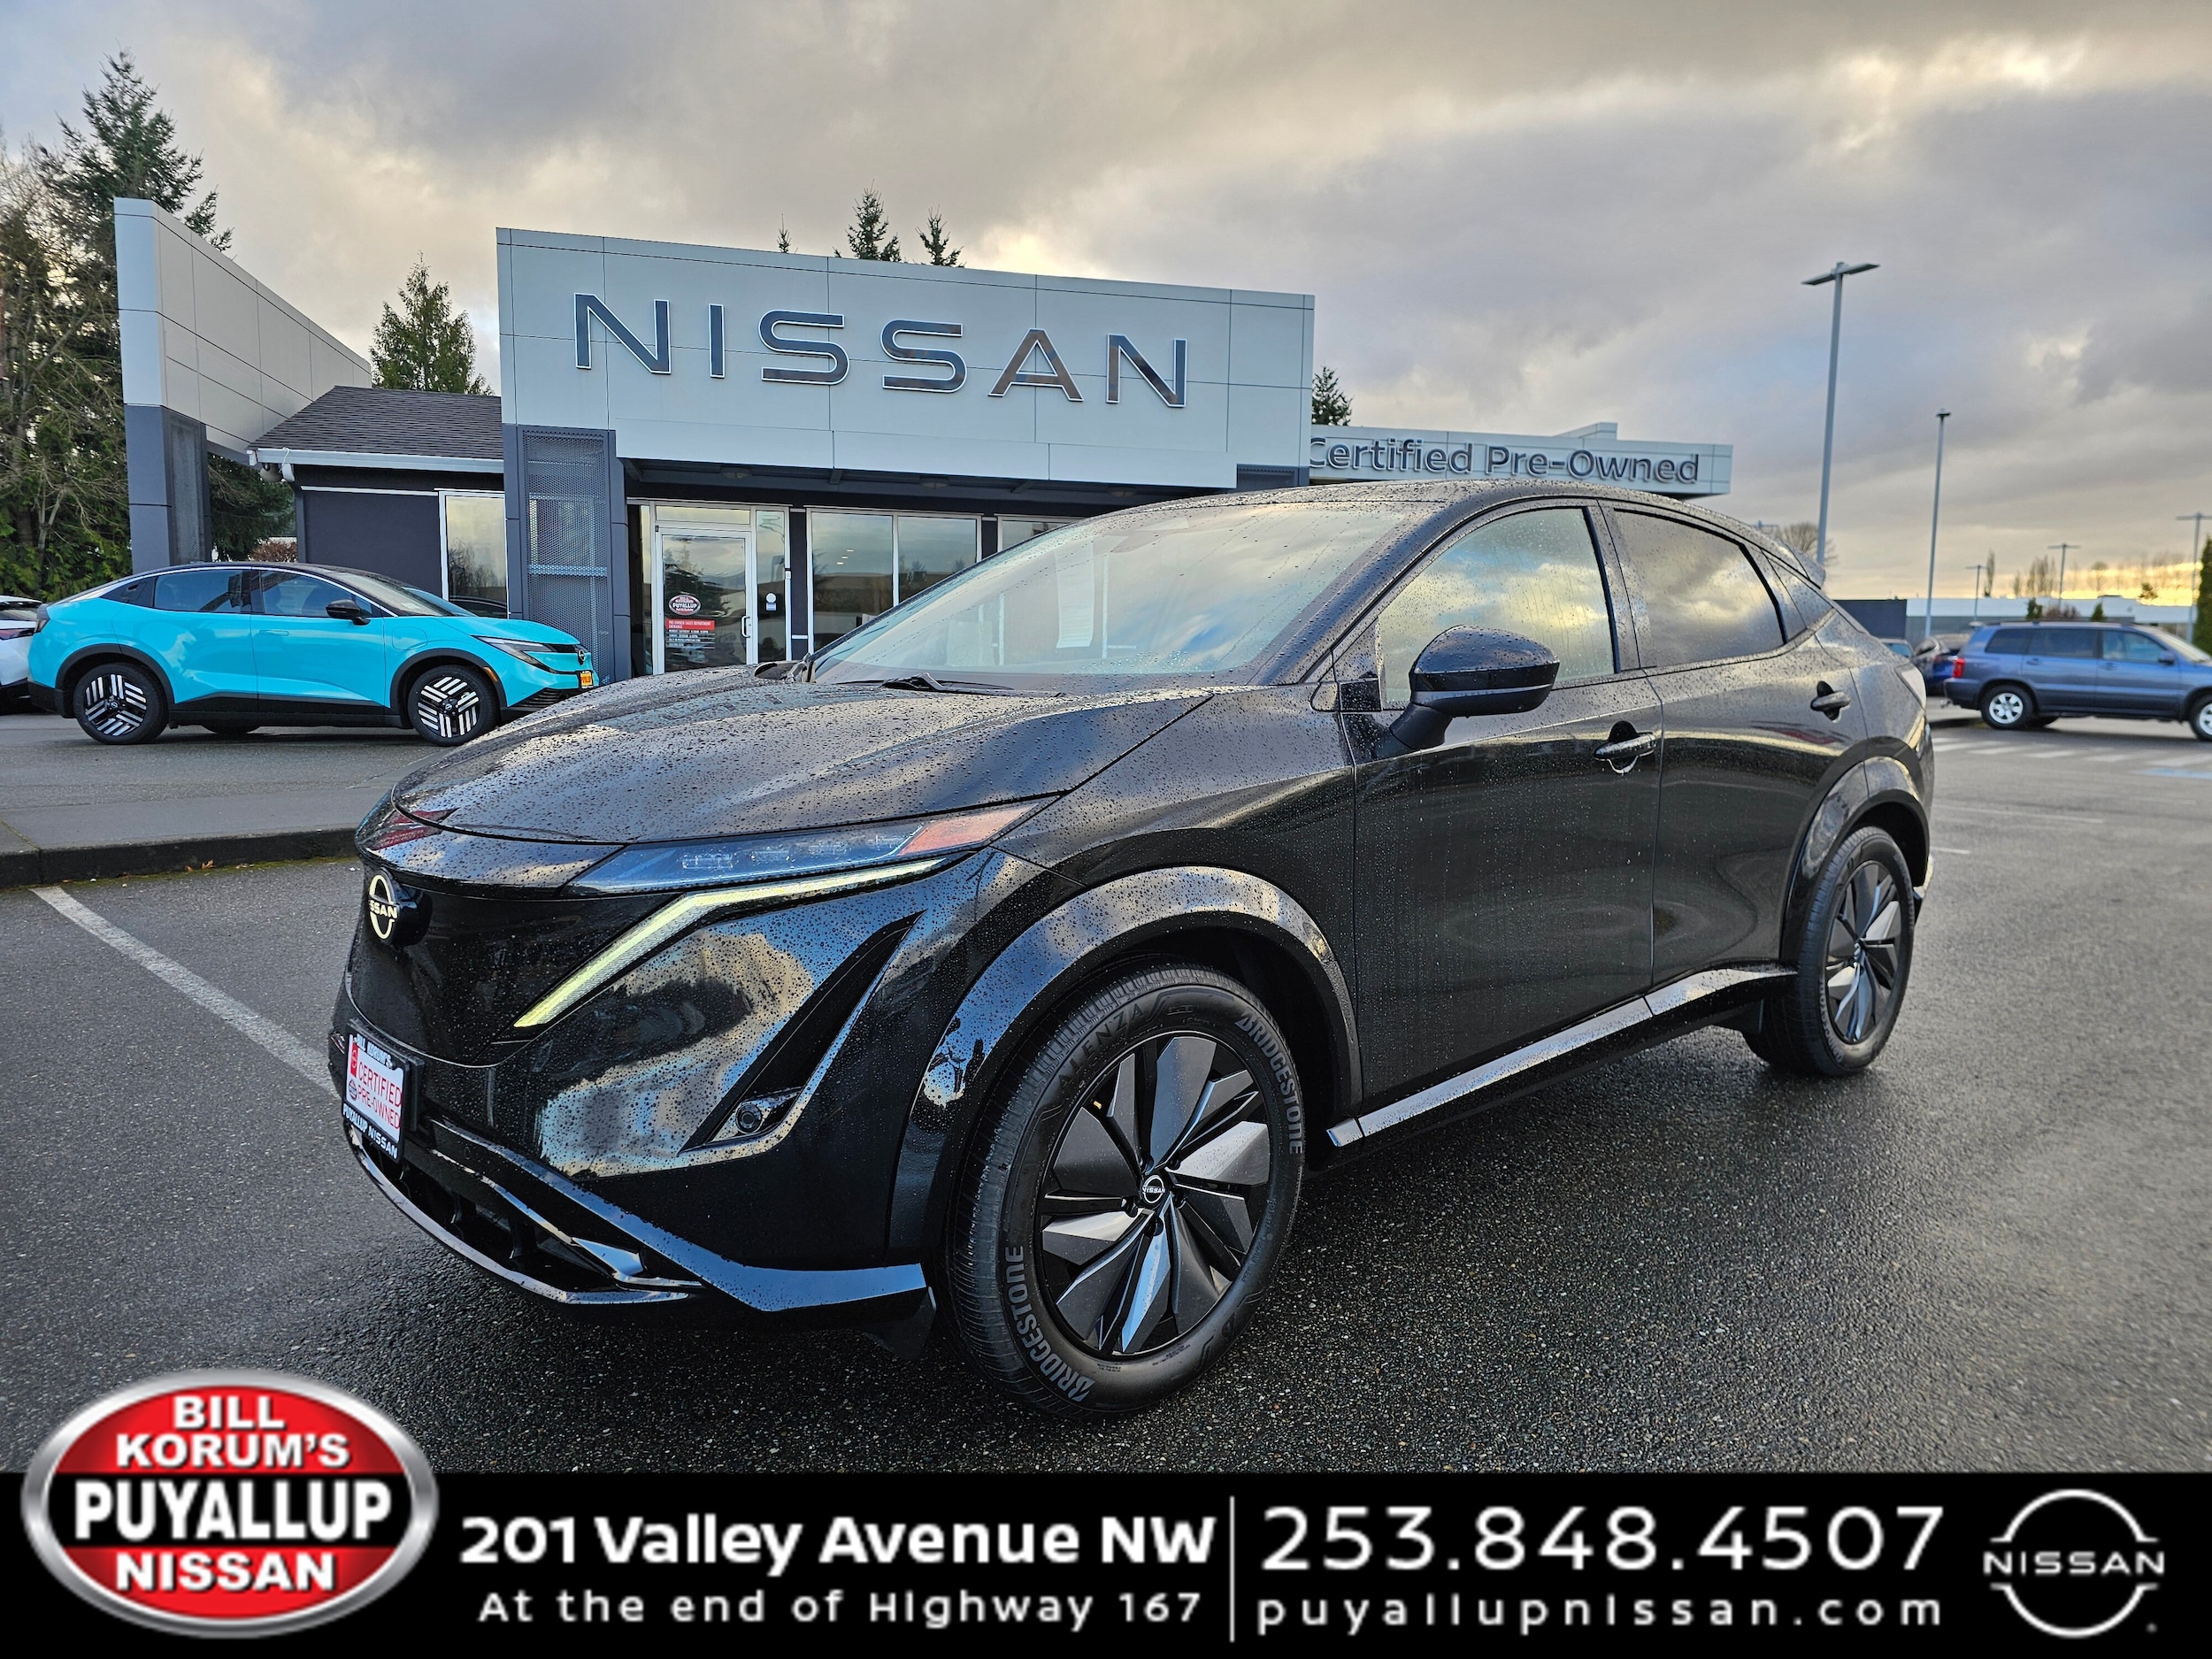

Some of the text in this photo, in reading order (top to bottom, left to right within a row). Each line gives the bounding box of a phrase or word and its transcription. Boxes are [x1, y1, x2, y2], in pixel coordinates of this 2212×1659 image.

[573, 291, 1187, 409] NISSAN
[1310, 435, 1700, 485] Certified Pre-Owned
[368, 899, 398, 919] SSAN
[357, 1061, 403, 1108] CERTIFIED
[357, 1084, 402, 1130] PRE-OWNED
[1234, 1005, 1304, 1156] BRIDGESTONE
[342, 1102, 398, 1160] PUYALLUP NISSAN
[1004, 1244, 1096, 1403] BRIDGESTONE
